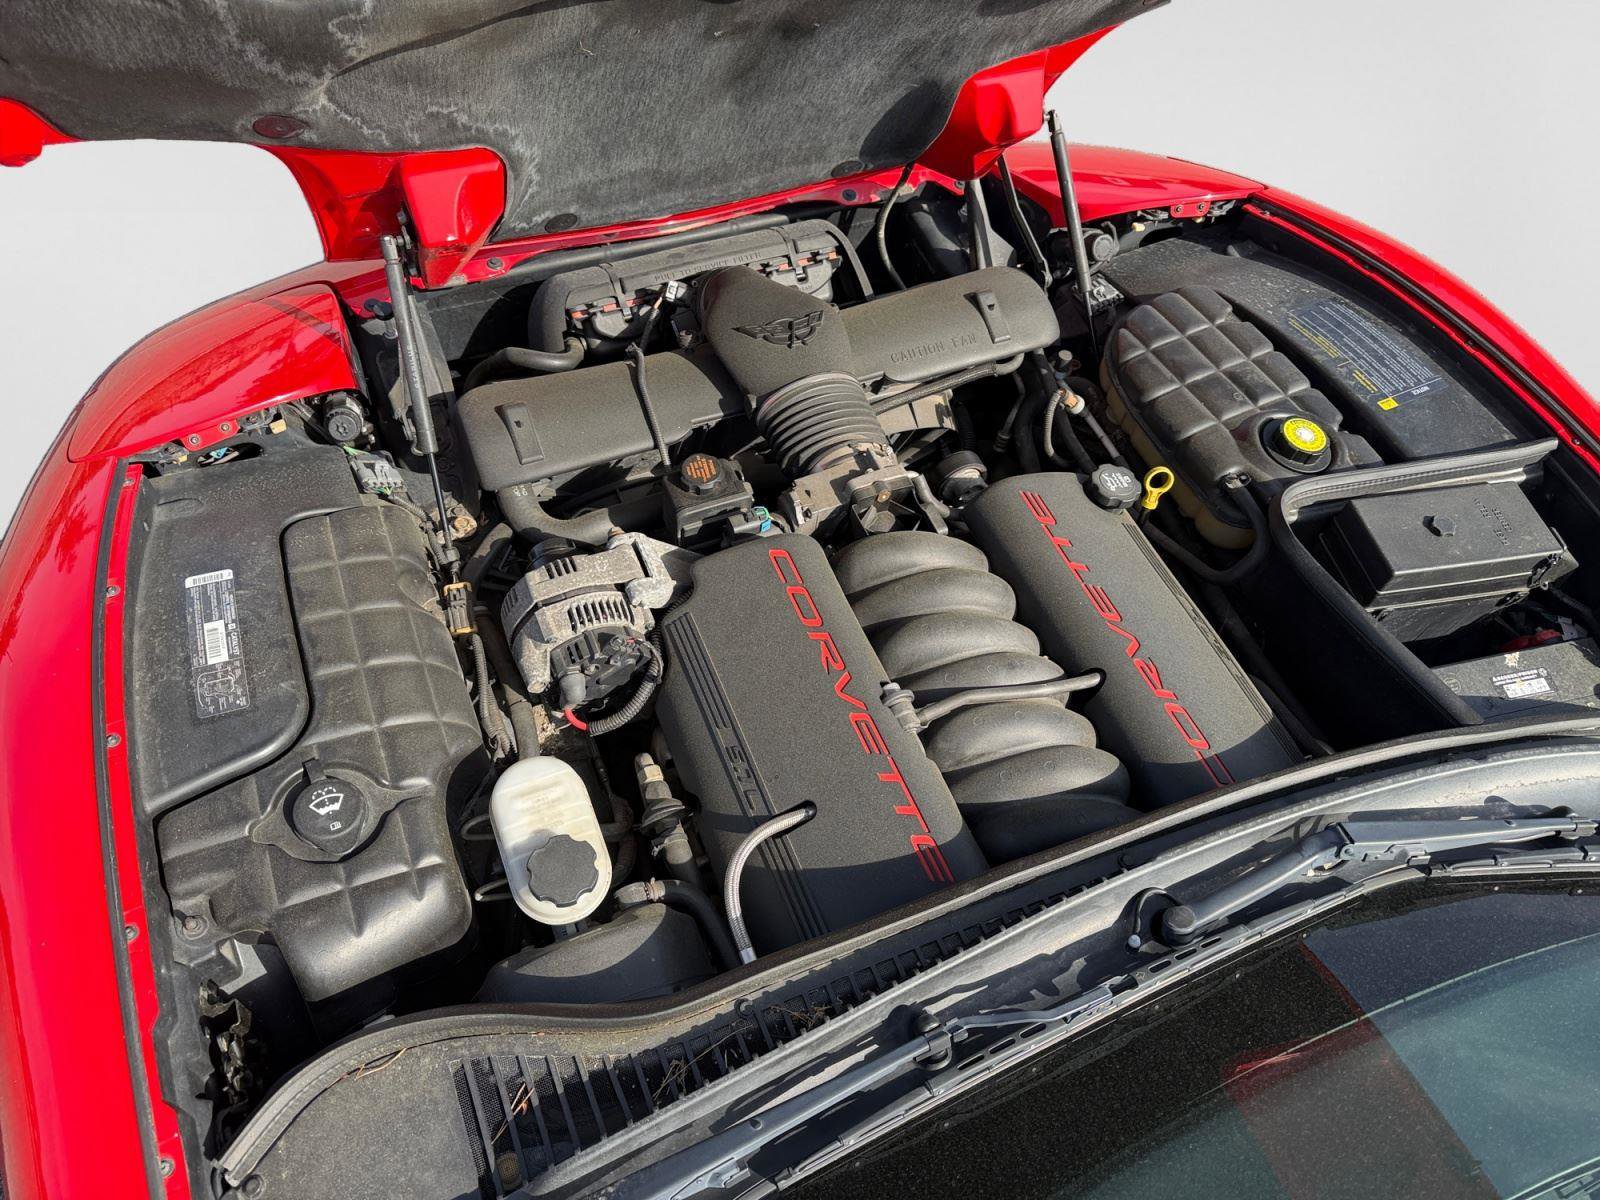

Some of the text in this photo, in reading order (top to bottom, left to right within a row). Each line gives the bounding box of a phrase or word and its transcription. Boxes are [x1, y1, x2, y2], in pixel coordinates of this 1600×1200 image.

[733, 251, 762, 265] FILTER
[890, 332, 977, 363] CAUTION FAN
[1019, 490, 1237, 787] CORVETTE
[769, 549, 955, 883] CORVETTE
[725, 745, 756, 810] 5.7L
